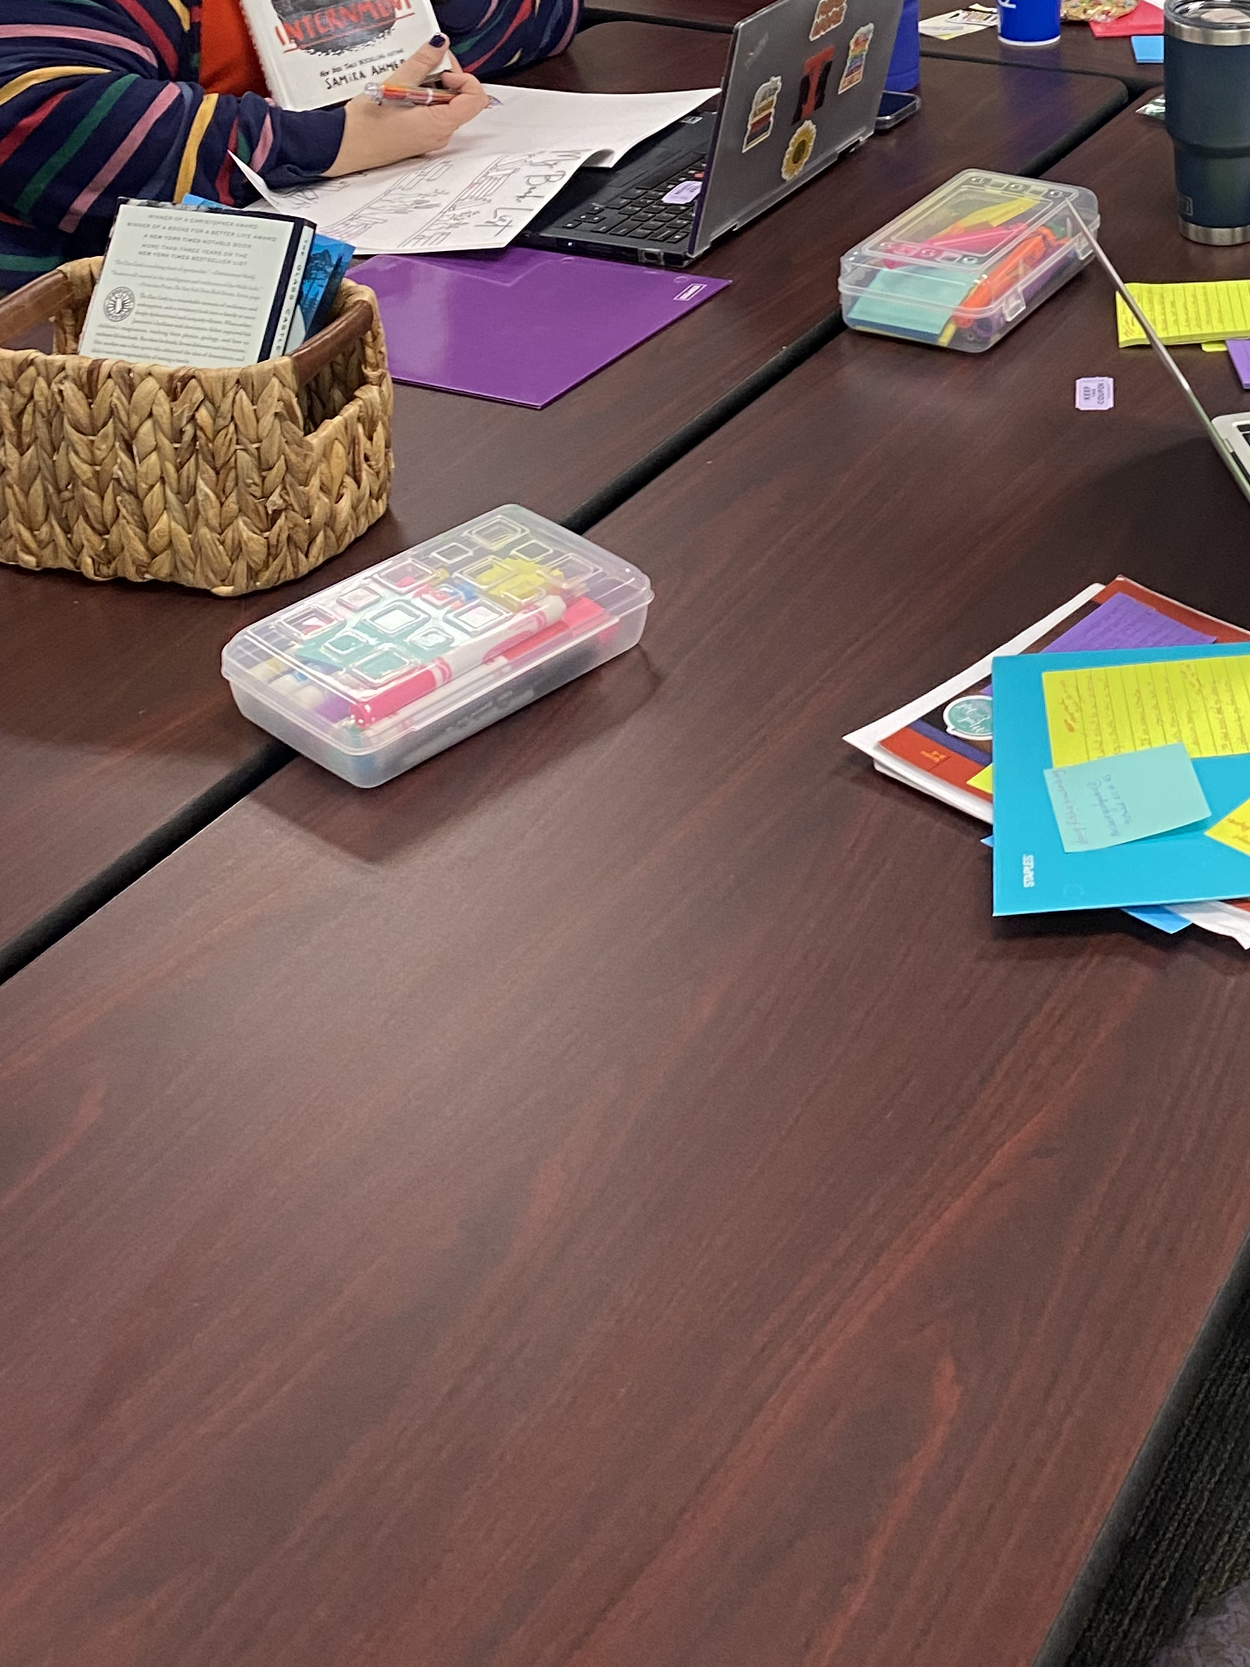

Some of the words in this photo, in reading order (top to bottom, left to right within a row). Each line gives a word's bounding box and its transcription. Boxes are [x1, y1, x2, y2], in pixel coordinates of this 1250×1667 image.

[325, 70, 366, 89] SAMIRA
[1083, 386, 1091, 401] KEEP
[1097, 383, 1105, 405] COUPON
[1022, 854, 1035, 888] STAPLES
